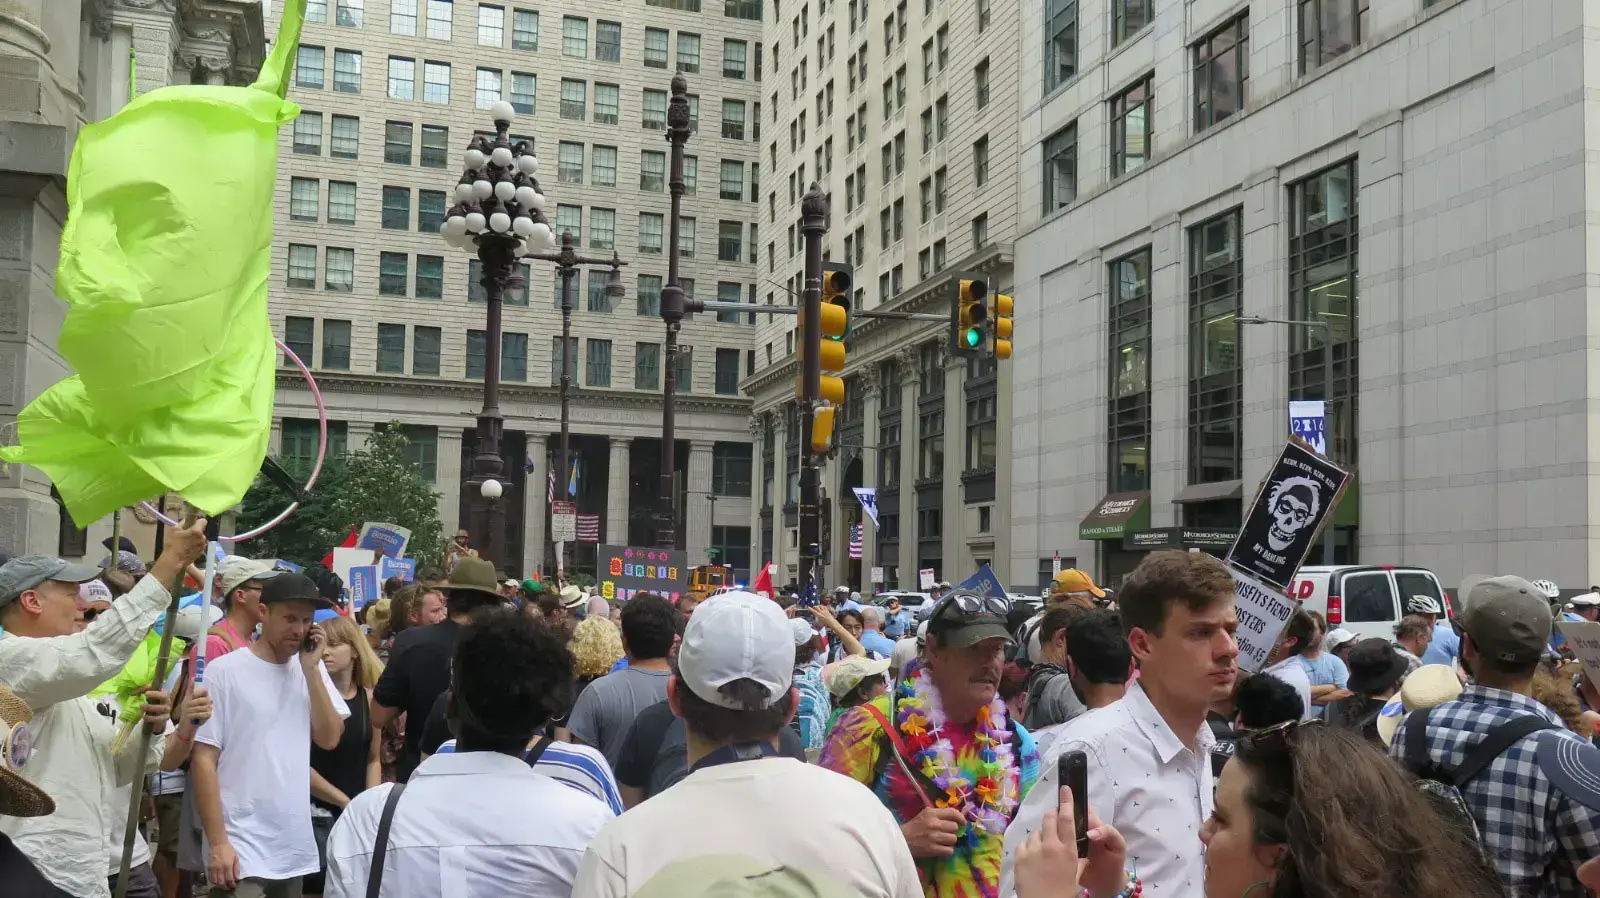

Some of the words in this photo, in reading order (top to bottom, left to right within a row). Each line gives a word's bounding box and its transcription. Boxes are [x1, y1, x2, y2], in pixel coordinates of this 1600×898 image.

[387, 559, 412, 570] Bernie
[610, 557, 678, 580] BERNIE
[1287, 580, 1314, 599] LD
[1235, 605, 1266, 634] OSTERS
[1266, 597, 1291, 622] FIEND
[1253, 647, 1266, 663] $5
